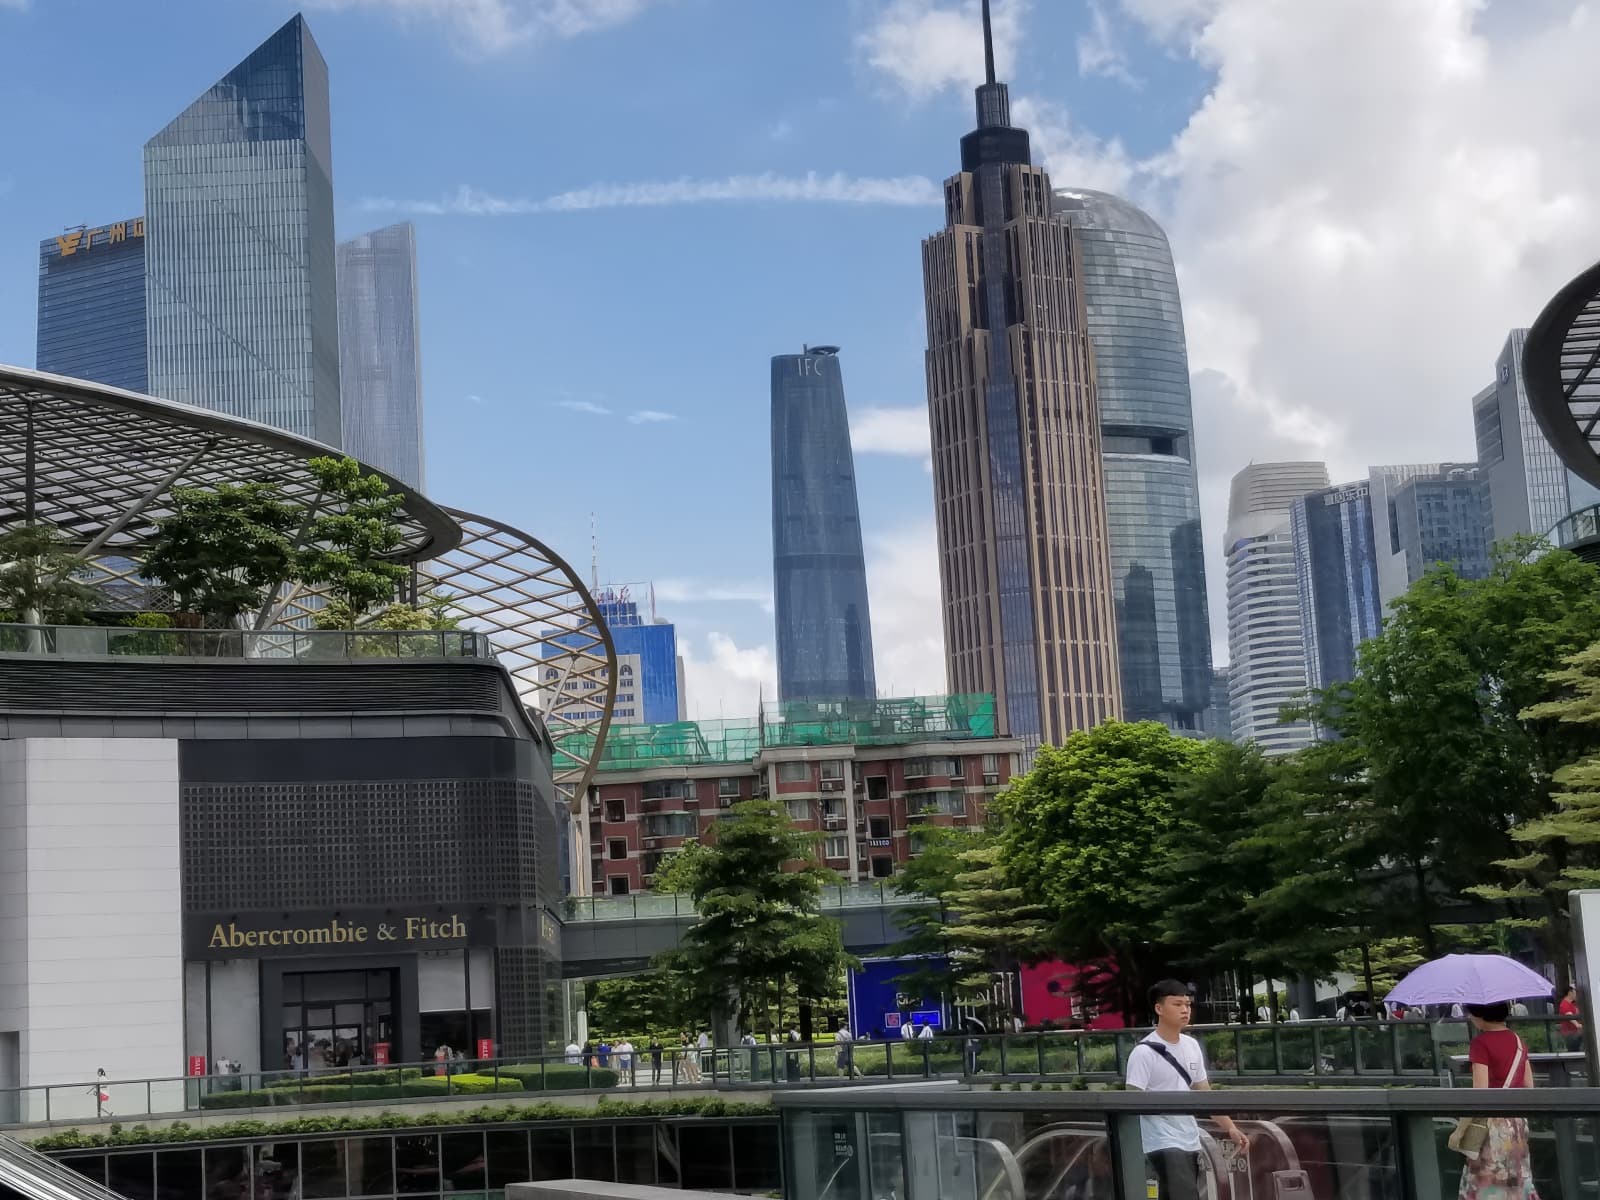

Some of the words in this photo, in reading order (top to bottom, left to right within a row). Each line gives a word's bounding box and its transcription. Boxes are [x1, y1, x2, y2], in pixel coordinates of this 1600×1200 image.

[207, 919, 368, 948] Abercrombie
[376, 923, 397, 941] &
[404, 914, 467, 940] Fitch
